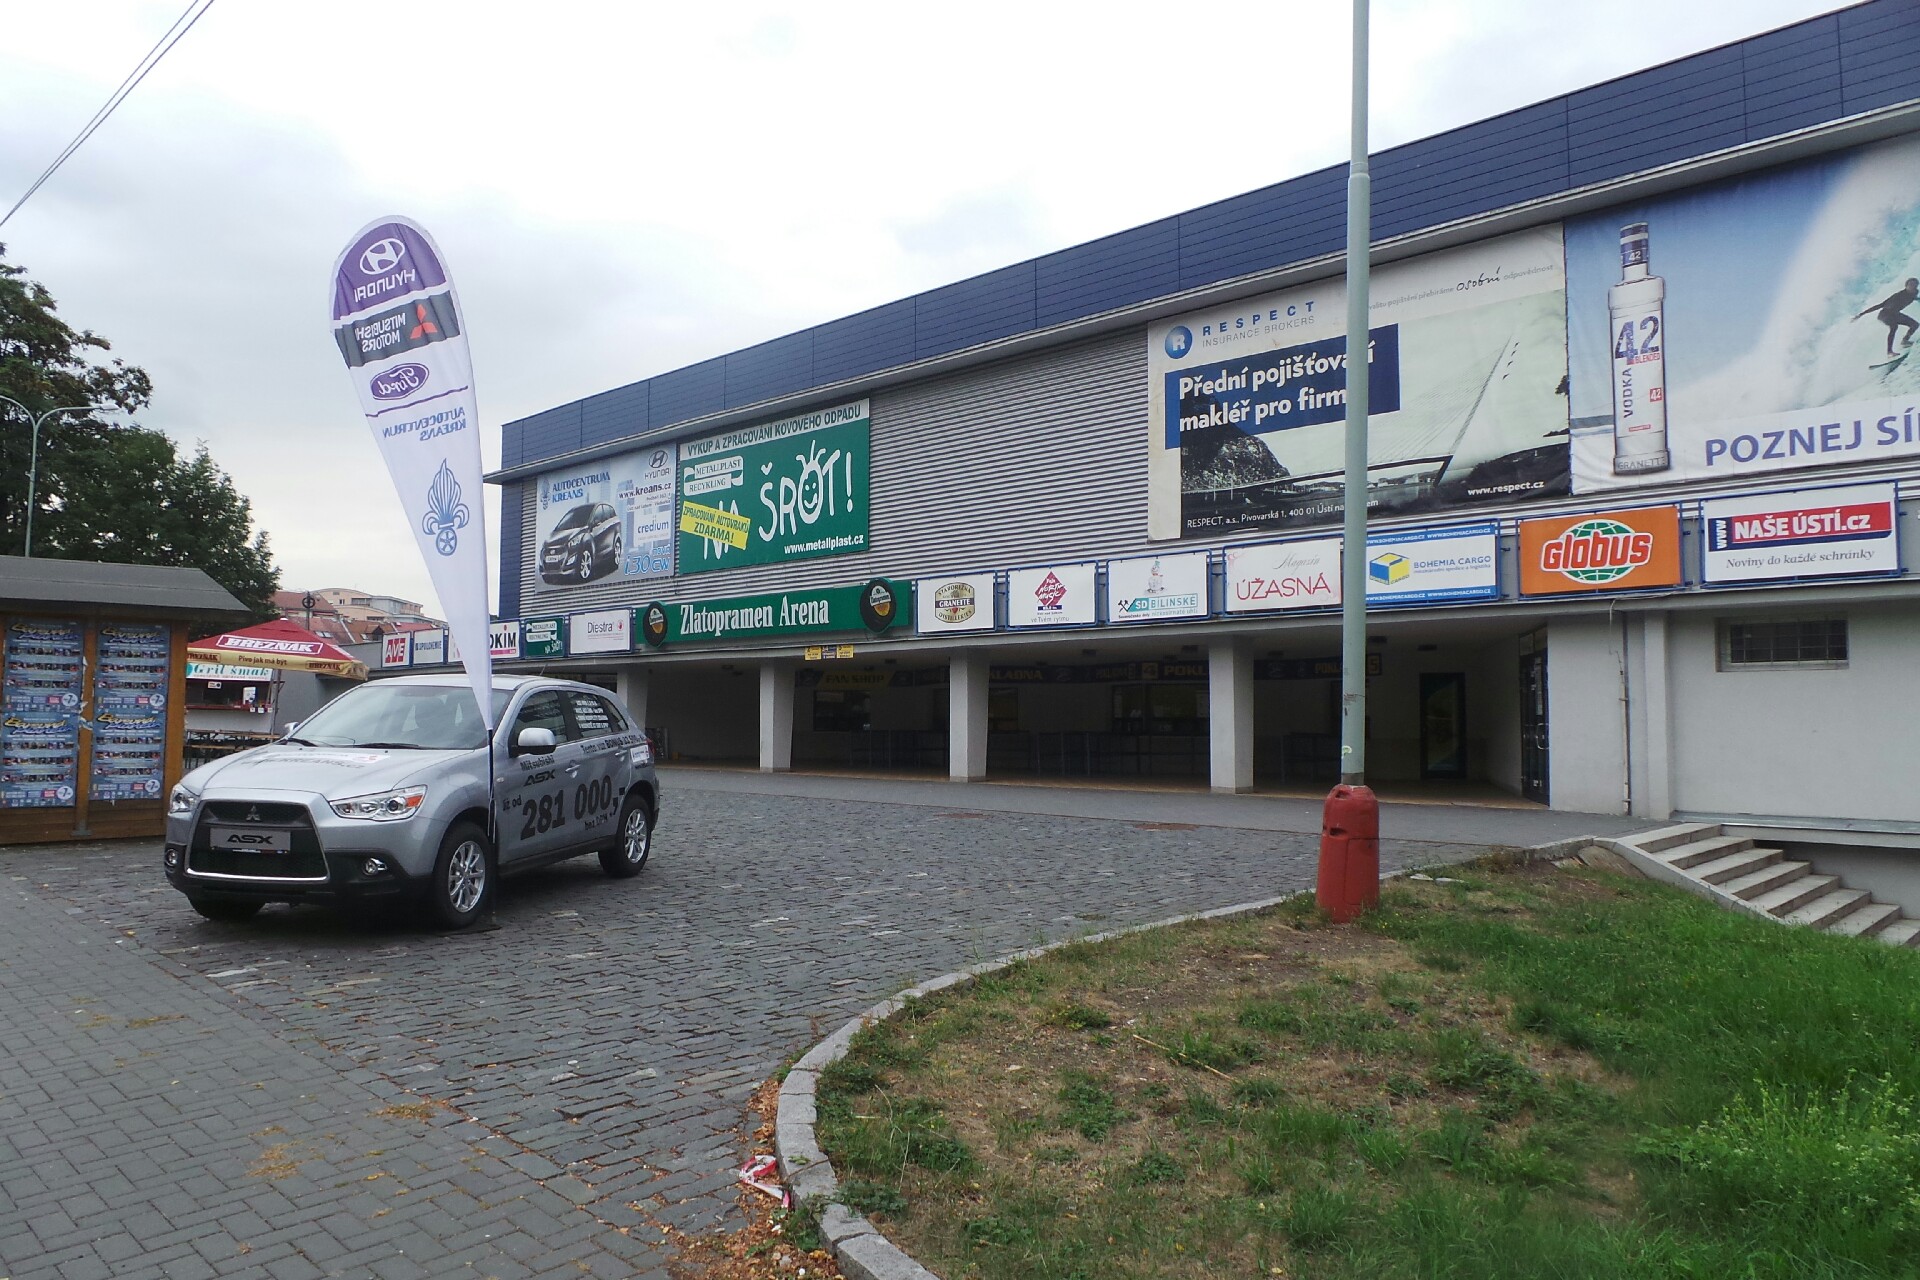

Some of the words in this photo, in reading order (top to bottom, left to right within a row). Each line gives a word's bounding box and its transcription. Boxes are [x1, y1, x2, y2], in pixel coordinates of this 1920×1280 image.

[1629, 250, 1641, 261] 42
[1456, 266, 1501, 291] osobní
[1203, 301, 1315, 337] RESPECT
[1203, 323, 1260, 348] INSURANCE
[1264, 315, 1315, 334] BROKERS
[1615, 315, 1660, 365] 42
[1635, 352, 1660, 364] BLENDED
[1179, 367, 1249, 400] Přední
[1252, 340, 1376, 392] pojišťoví
[1622, 367, 1634, 419] VODKA
[1651, 388, 1661, 401] 42
[1180, 399, 1250, 432] makléř
[1255, 399, 1292, 425] pro
[1298, 387, 1347, 411] firm
[715, 442, 721, 450] A
[722, 423, 773, 449] ZPRACOVÁNÍ
[774, 415, 822, 437] KOVOVÉHO
[825, 404, 861, 425] ODPADU
[1705, 420, 1862, 466] POZNEJ
[1877, 406, 1920, 446] SÍ
[552, 471, 611, 492] AUTOCENTRUM
[645, 467, 672, 480] HYUNDAI
[618, 482, 672, 499] www.kreans.cz
[689, 478, 726, 493] RECYKLING
[1467, 480, 1545, 497] www.respect.cz
[552, 488, 584, 504] KREANS
[1187, 516, 1224, 528] RESPECT,
[1241, 510, 1279, 523] Pivovarská
[1289, 507, 1304, 517] 400
[1317, 502, 1333, 514] Ústí
[637, 519, 669, 534] credium
[694, 522, 735, 543] ZDARMA!
[1715, 520, 1728, 549] www
[1735, 515, 1790, 540] NAŠE
[1793, 509, 1871, 535] ÚSTÍ.cz
[784, 534, 864, 554] www.metallplast.cz
[1542, 528, 1653, 571] Globus
[1414, 558, 1456, 569] BOHEMIA
[1458, 556, 1492, 565] CARGO
[1726, 558, 1764, 569] Noviny
[1767, 555, 1781, 565] do
[1784, 550, 1816, 563] každé
[1819, 548, 1875, 562] schránky
[1236, 572, 1331, 600] ÚŽASNÁ
[939, 599, 971, 608] GRANETTE
[1135, 601, 1148, 610] SD
[680, 604, 774, 637] Zlatopramen
[778, 595, 830, 627] Arena
[587, 621, 613, 634] Diestra
[386, 640, 405, 658] AVE
[238, 655, 253, 663] Pivo
[253, 656, 264, 665] jak
[194, 665, 225, 675] Gril
[1164, 665, 1207, 676] POKL
[826, 674, 849, 684] FAN
[852, 674, 885, 683] SHOP
[604, 737, 624, 749] BONUS
[520, 755, 556, 772] Mitsubishi
[523, 769, 556, 786] ASX
[512, 794, 522, 808] od
[520, 789, 566, 841] 281
[227, 834, 275, 845] ASX
